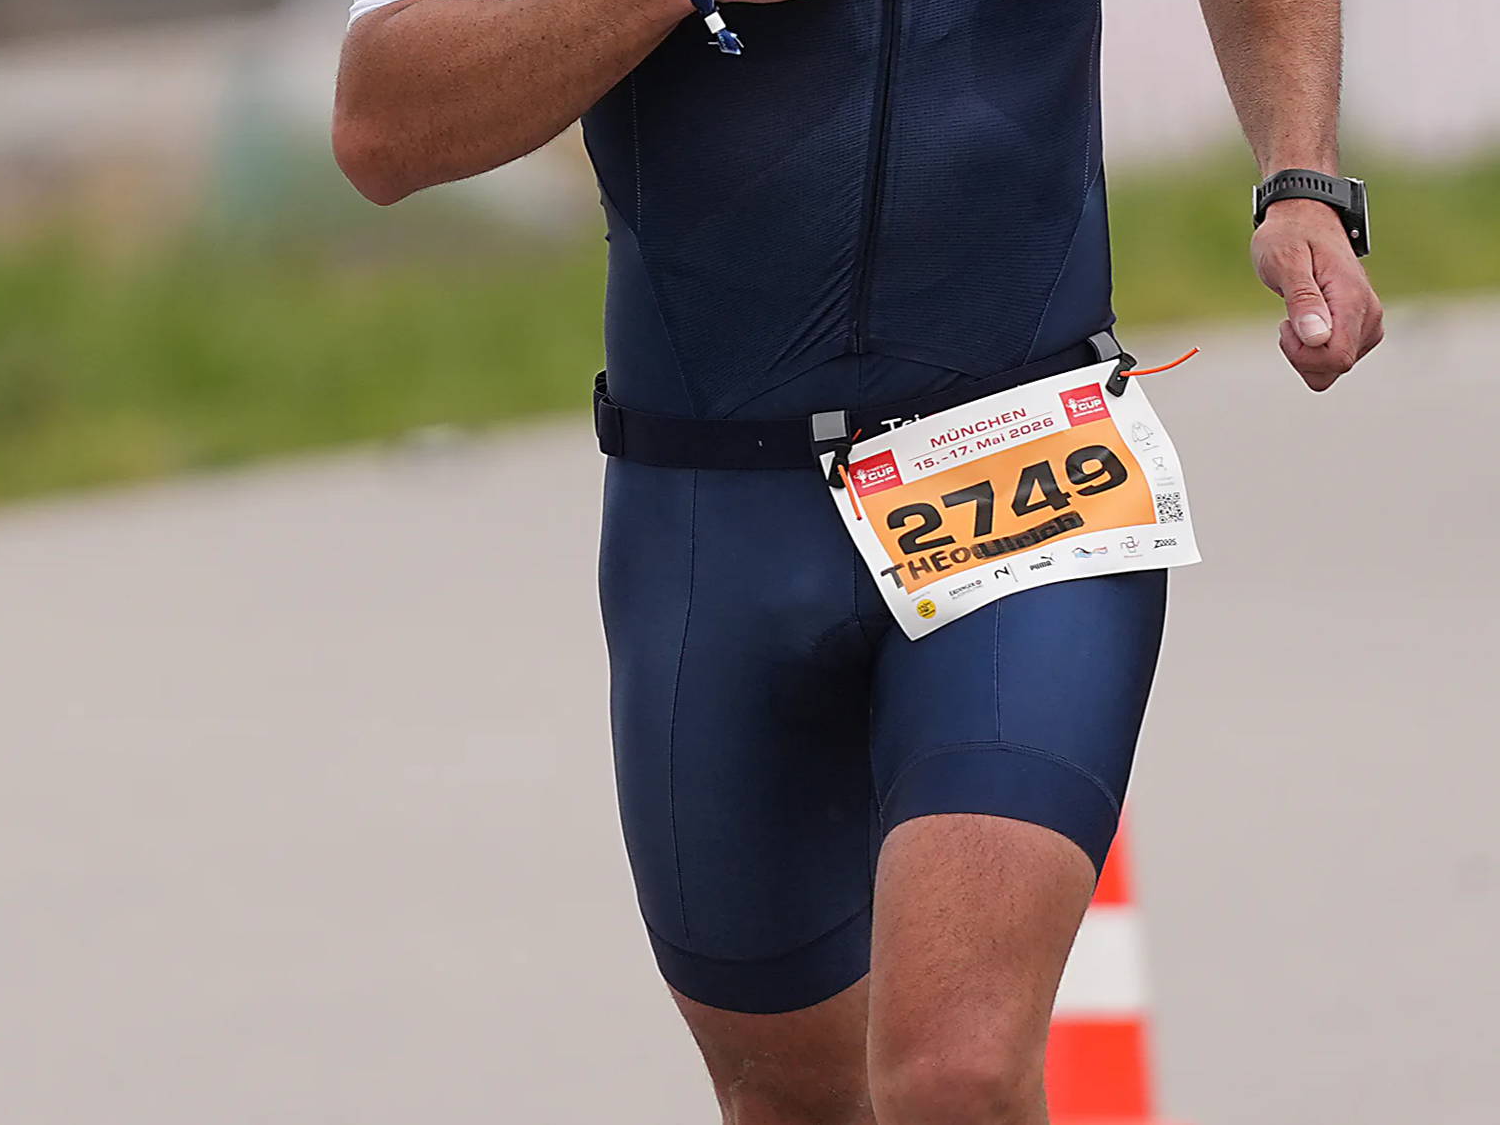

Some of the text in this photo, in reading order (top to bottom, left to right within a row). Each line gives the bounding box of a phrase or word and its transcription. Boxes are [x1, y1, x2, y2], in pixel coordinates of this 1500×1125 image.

[1078, 397, 1102, 413] CUP
[929, 407, 1027, 448] MÜNCHEN
[976, 433, 1005, 451] Mai
[1010, 417, 1054, 439] 2026
[867, 465, 895, 481] CUP
[887, 445, 1128, 555] 2749
[880, 546, 972, 589] THEO
